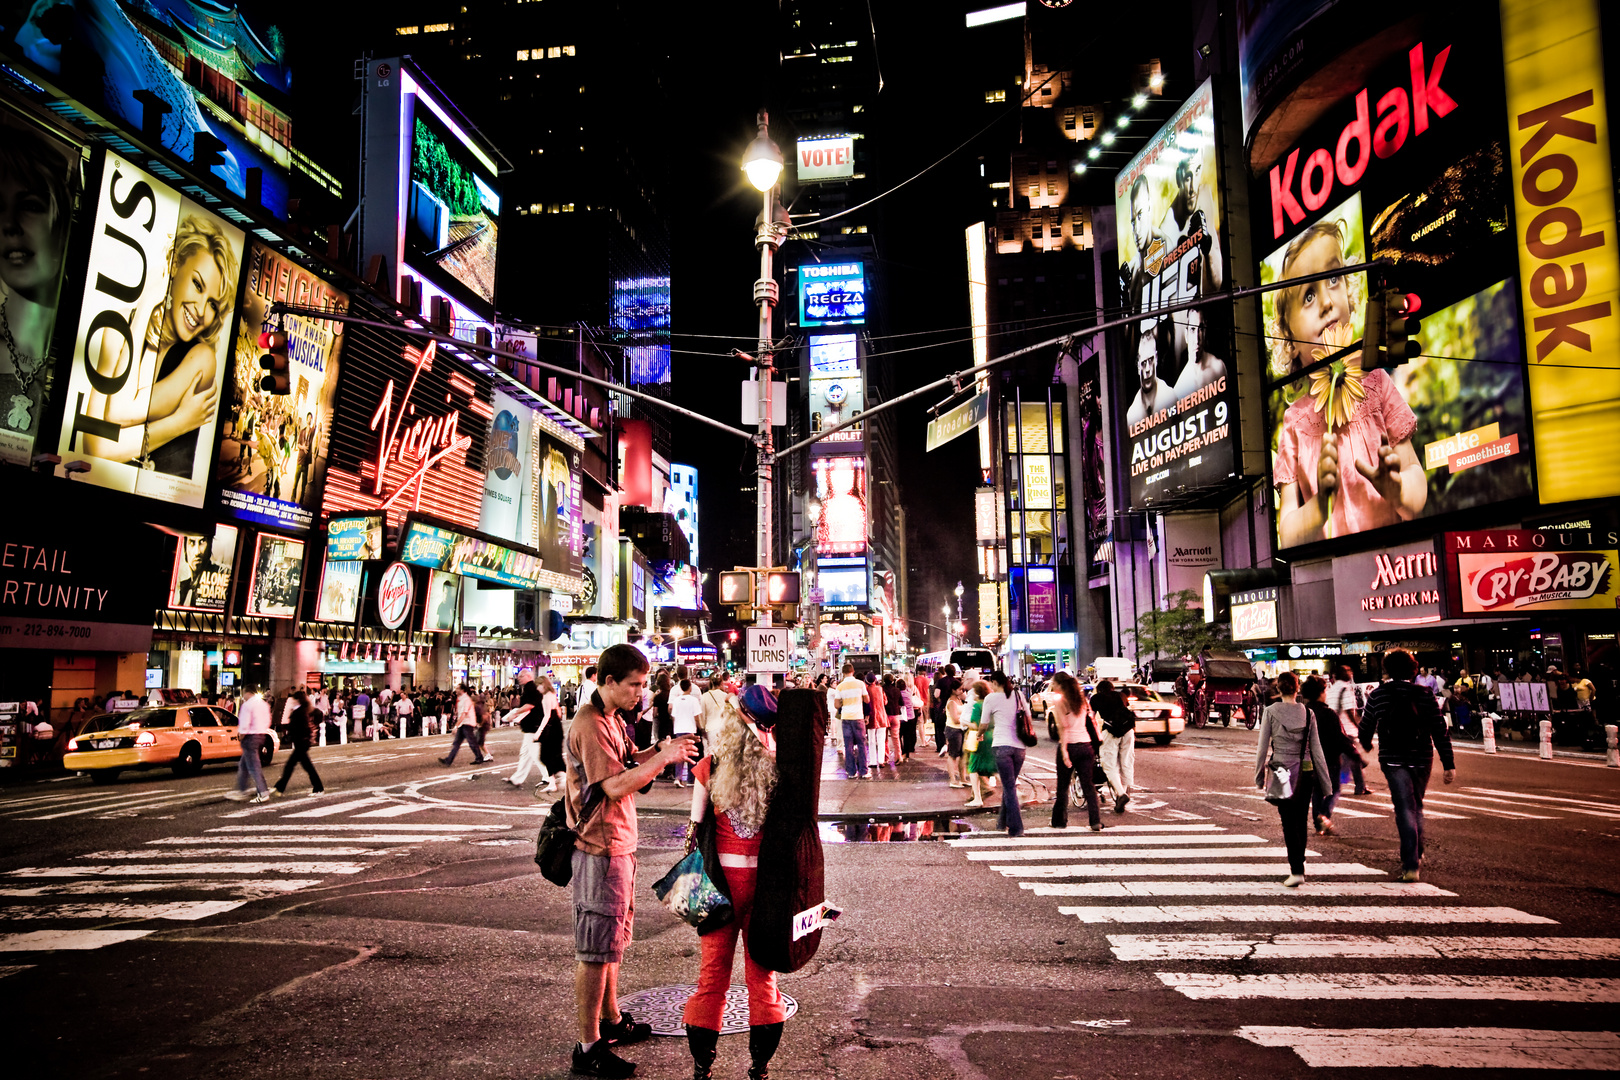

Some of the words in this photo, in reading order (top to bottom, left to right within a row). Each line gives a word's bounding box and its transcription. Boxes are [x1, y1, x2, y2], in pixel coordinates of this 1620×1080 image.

[1270, 42, 1459, 240] Kodak
[801, 147, 850, 168] VOTE!
[1411, 231, 1420, 242] ON
[1421, 214, 1445, 237] AUGUST
[1445, 208, 1457, 223] 1ST
[1517, 89, 1612, 364] Kodak
[1163, 229, 1203, 268] PRESENTS
[802, 264, 860, 278] TOSHIBA
[1190, 258, 1198, 275] 87
[809, 292, 864, 304] REGZA
[68, 169, 157, 453] TOUS
[285, 314, 303, 331] TONY
[304, 326, 327, 347] AWARD
[288, 333, 324, 373] MUSICAL
[1129, 408, 1167, 438] LESNAR
[1176, 376, 1227, 415] HERRING
[936, 405, 980, 440] Broadway
[1131, 409, 1209, 465] AUGUST
[1214, 401, 1228, 427] 9
[1131, 457, 1149, 477] LIVE
[1150, 452, 1164, 469] ON
[1165, 423, 1229, 464] PAY-PER-VIEW
[1428, 431, 1480, 462] make
[1456, 441, 1511, 467] something
[1029, 465, 1045, 473] THE
[1027, 474, 1048, 488] LION
[484, 488, 497, 499] TIMES
[497, 492, 512, 504] SQUARE
[1027, 488, 1049, 502] KING
[1456, 531, 1618, 549] MARQUIS
[2, 543, 72, 575] ETAIL
[1173, 546, 1212, 558] Marriott
[199, 571, 230, 587] ALONE
[1371, 552, 1437, 591] Marri
[1471, 552, 1611, 608] CRY-BABY
[3, 580, 109, 612] RTUNITY
[201, 585, 227, 600] DARK
[1231, 589, 1277, 605] MARQUIS
[1361, 597, 1385, 611] NEW
[1386, 591, 1418, 609] YORK
[1539, 590, 1572, 601] MUSICAL
[24, 624, 91, 638] 212-894-7000
[759, 634, 776, 647] NO
[551, 657, 582, 665] swatch
[752, 650, 785, 663] TURNS
[1302, 645, 1341, 658] sunglass
